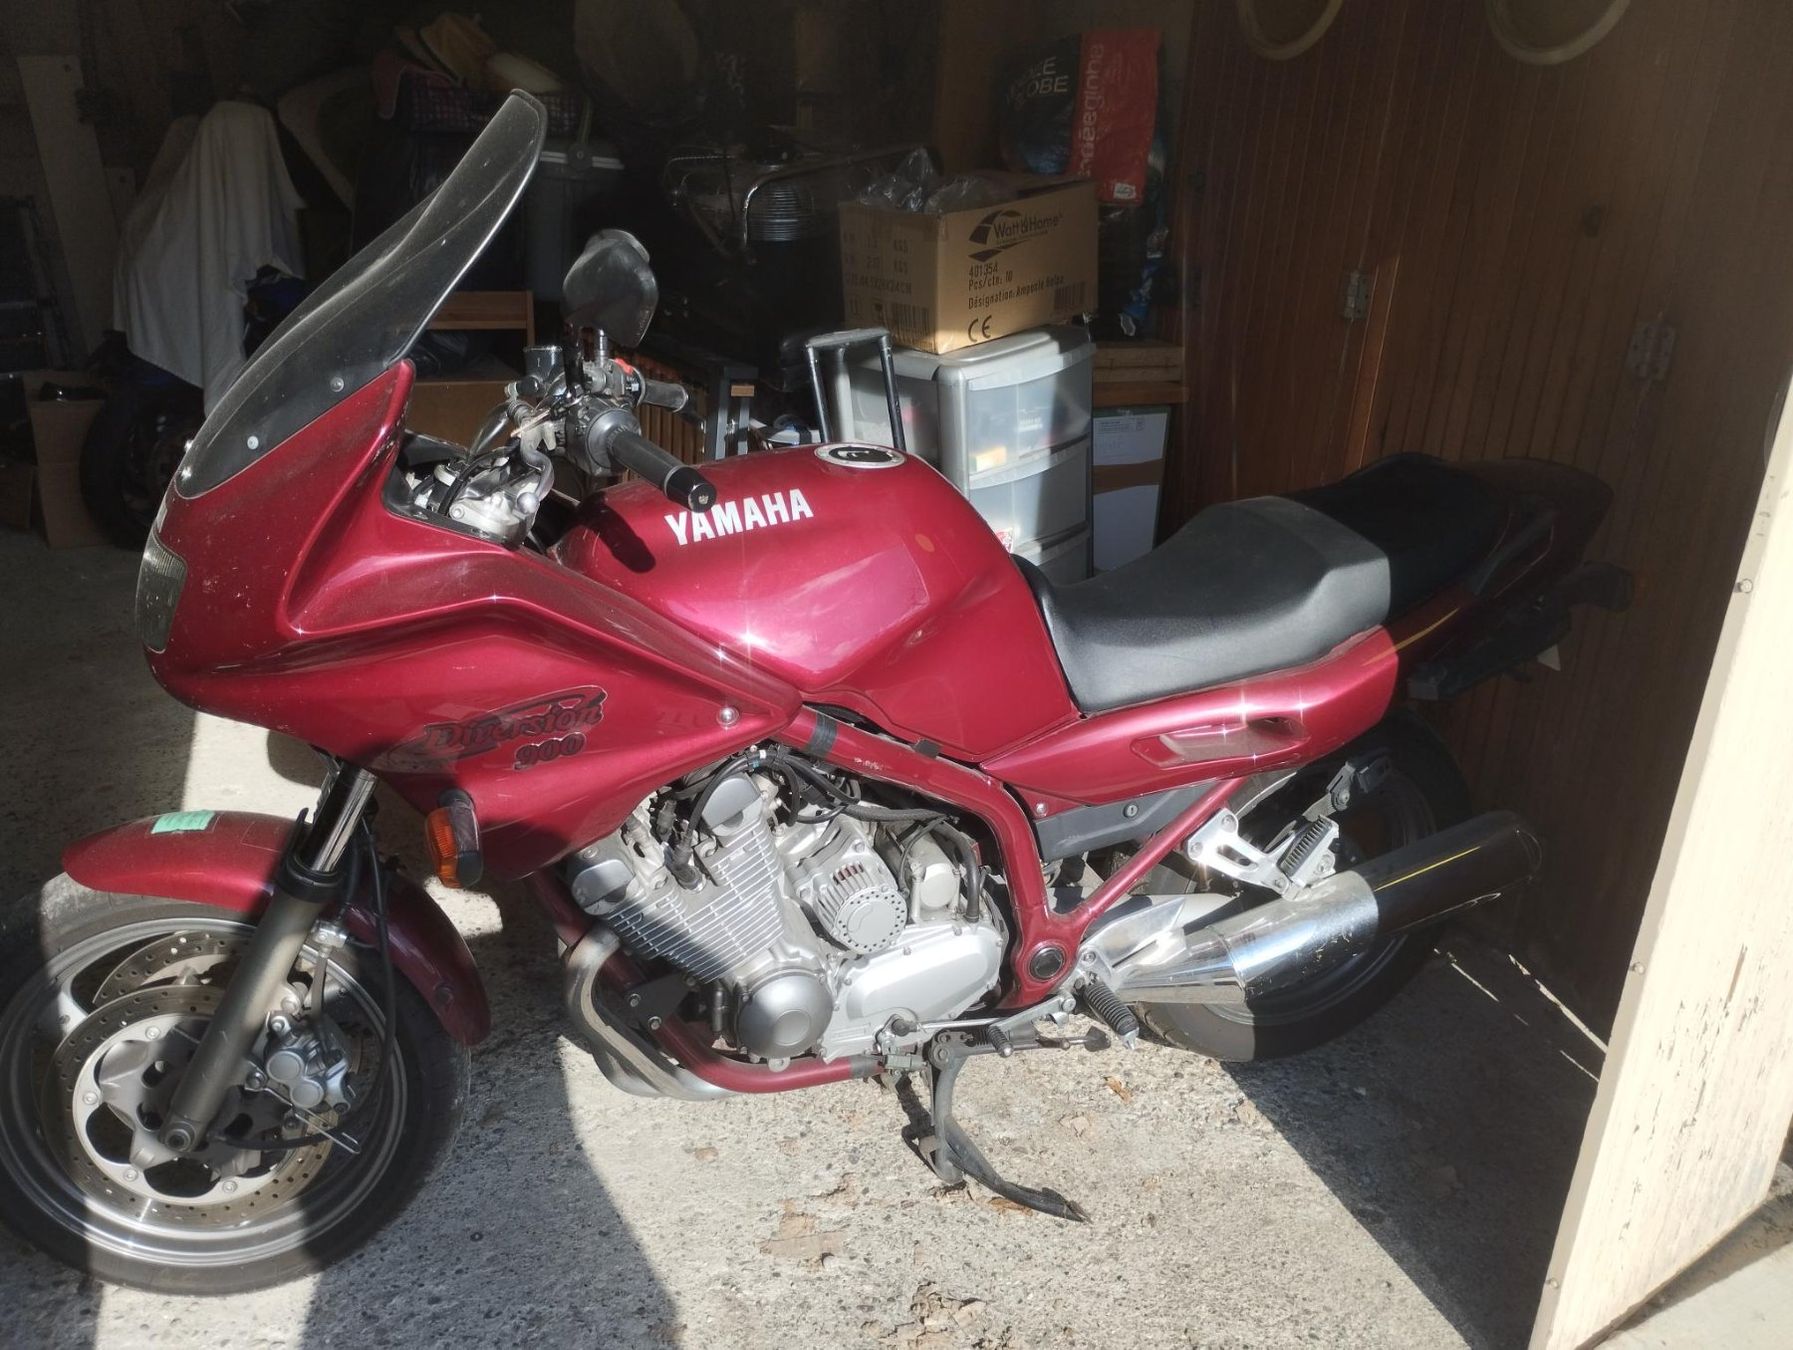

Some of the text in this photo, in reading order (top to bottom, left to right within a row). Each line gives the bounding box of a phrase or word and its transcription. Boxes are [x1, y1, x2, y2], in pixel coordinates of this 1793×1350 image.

[664, 488, 814, 546] YAMAHA
[423, 702, 604, 751] Diversion
[513, 732, 587, 771] 900
